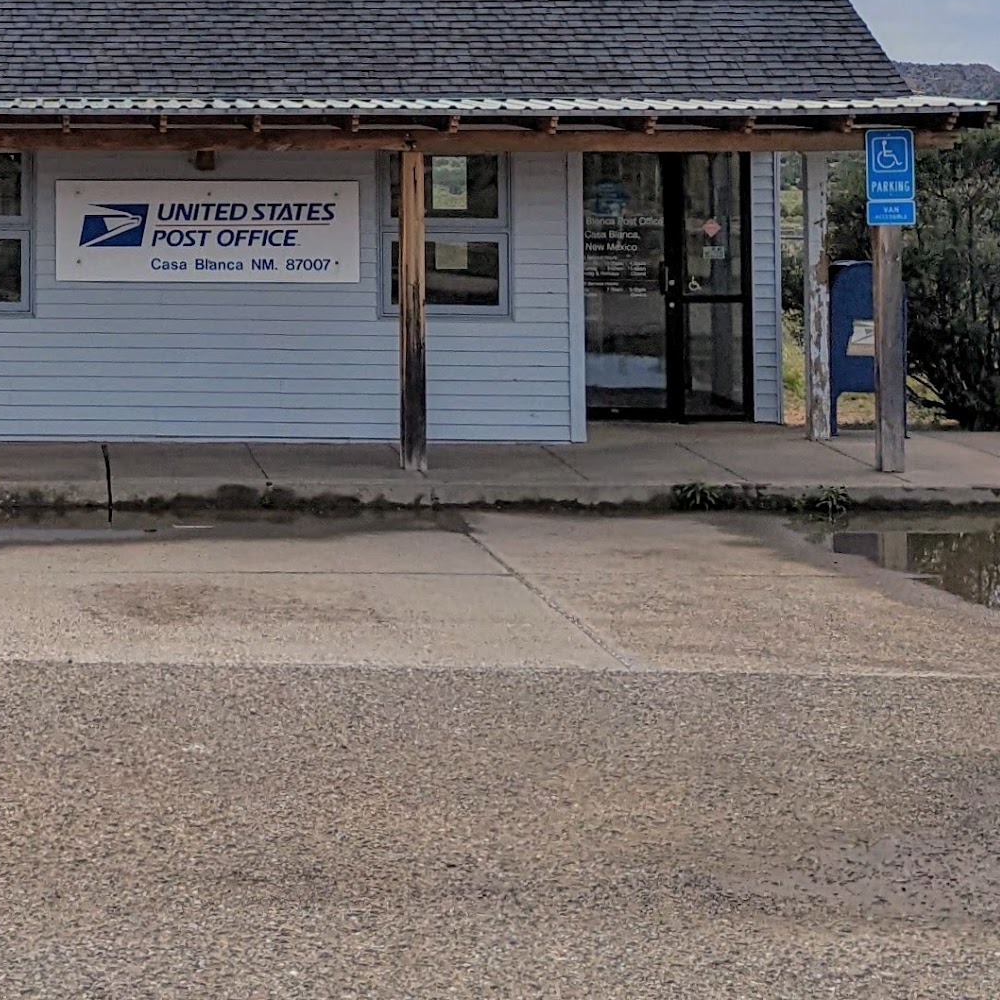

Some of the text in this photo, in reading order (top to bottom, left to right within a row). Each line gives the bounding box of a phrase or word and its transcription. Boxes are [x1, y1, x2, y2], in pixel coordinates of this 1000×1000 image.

[871, 181, 910, 192] PARKING
[157, 203, 336, 221] UNITED STATES
[617, 216, 637, 226] Post
[151, 229, 299, 247] POST OFFICE
[584, 230, 606, 239] Casa
[585, 243, 638, 251] New Mexico
[151, 258, 331, 271] Casa Blanca NM. 87007
